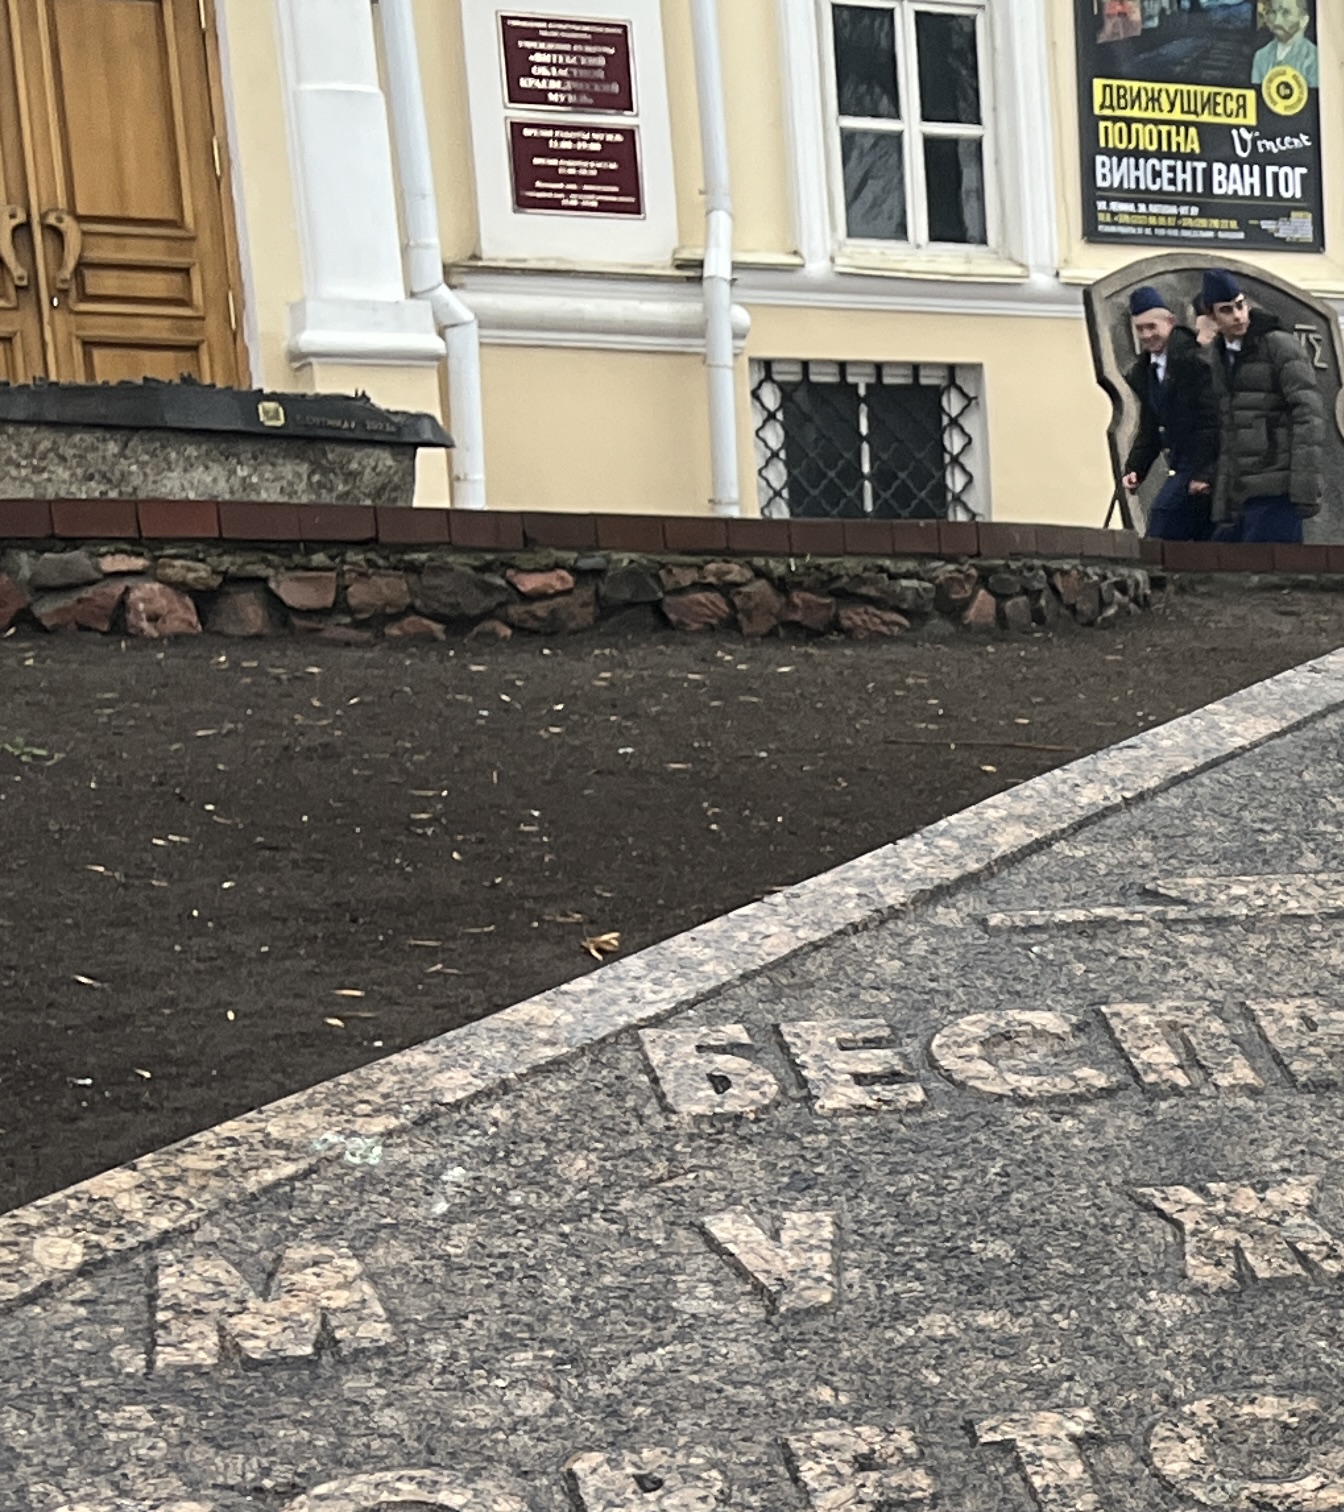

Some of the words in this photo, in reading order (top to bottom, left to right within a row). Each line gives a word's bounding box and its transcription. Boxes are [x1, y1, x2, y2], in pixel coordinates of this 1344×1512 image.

[1099, 83, 1248, 119] ДВИЖУЩИЕСЯ
[1098, 121, 1200, 154] ПОЛОТНА
[1231, 127, 1312, 158] Vincent
[1095, 155, 1207, 194] ВИНСЕНТ
[1212, 162, 1260, 197] ВАН
[1266, 165, 1307, 198] ГОГ
